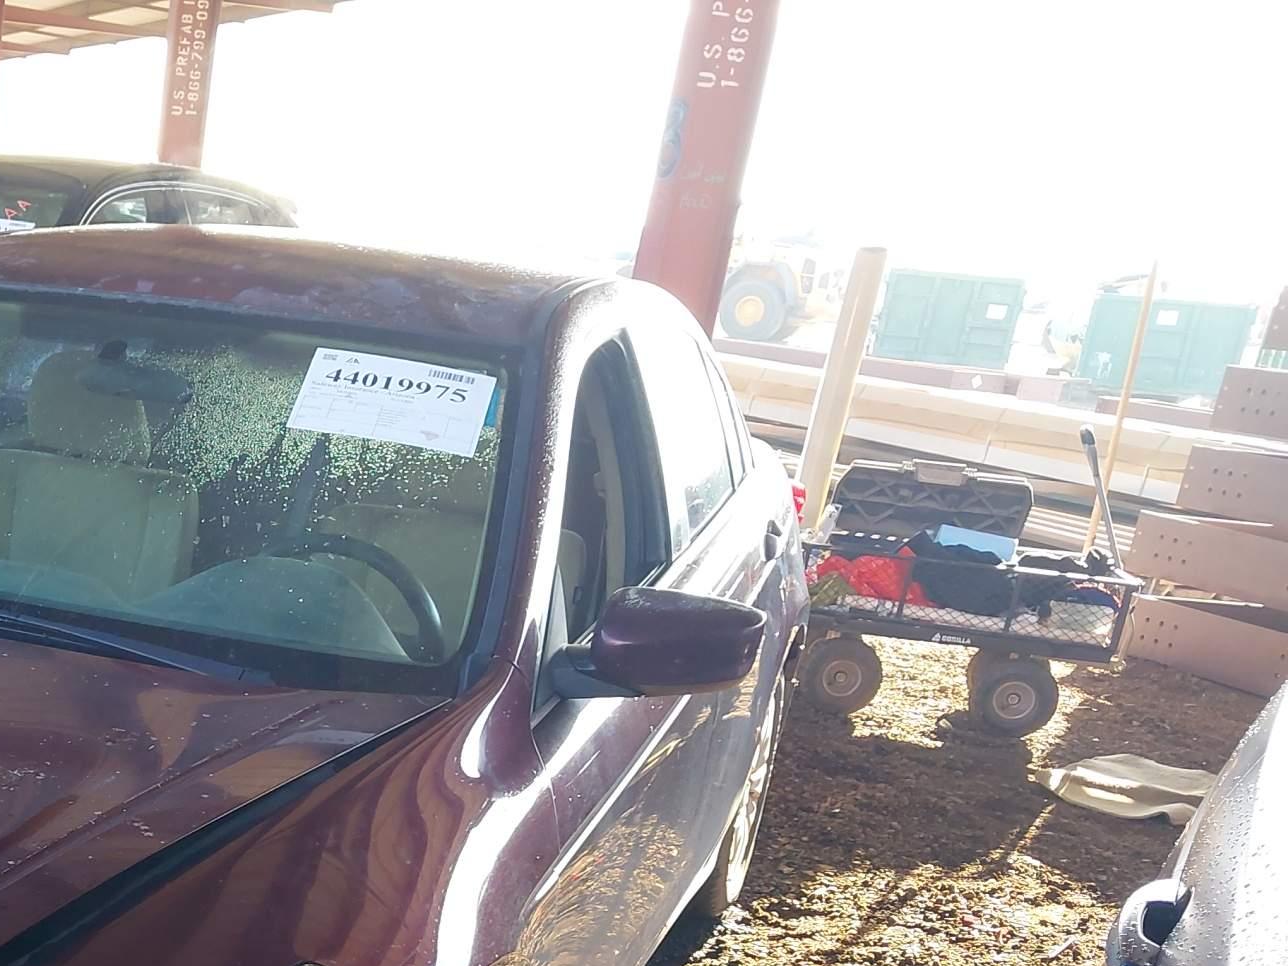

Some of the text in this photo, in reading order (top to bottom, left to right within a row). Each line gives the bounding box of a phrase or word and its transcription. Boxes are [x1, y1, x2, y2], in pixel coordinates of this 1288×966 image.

[175, 14, 194, 77] PREFAB
[325, 367, 469, 403] 44019975
[941, 635, 972, 644] GORILLA
